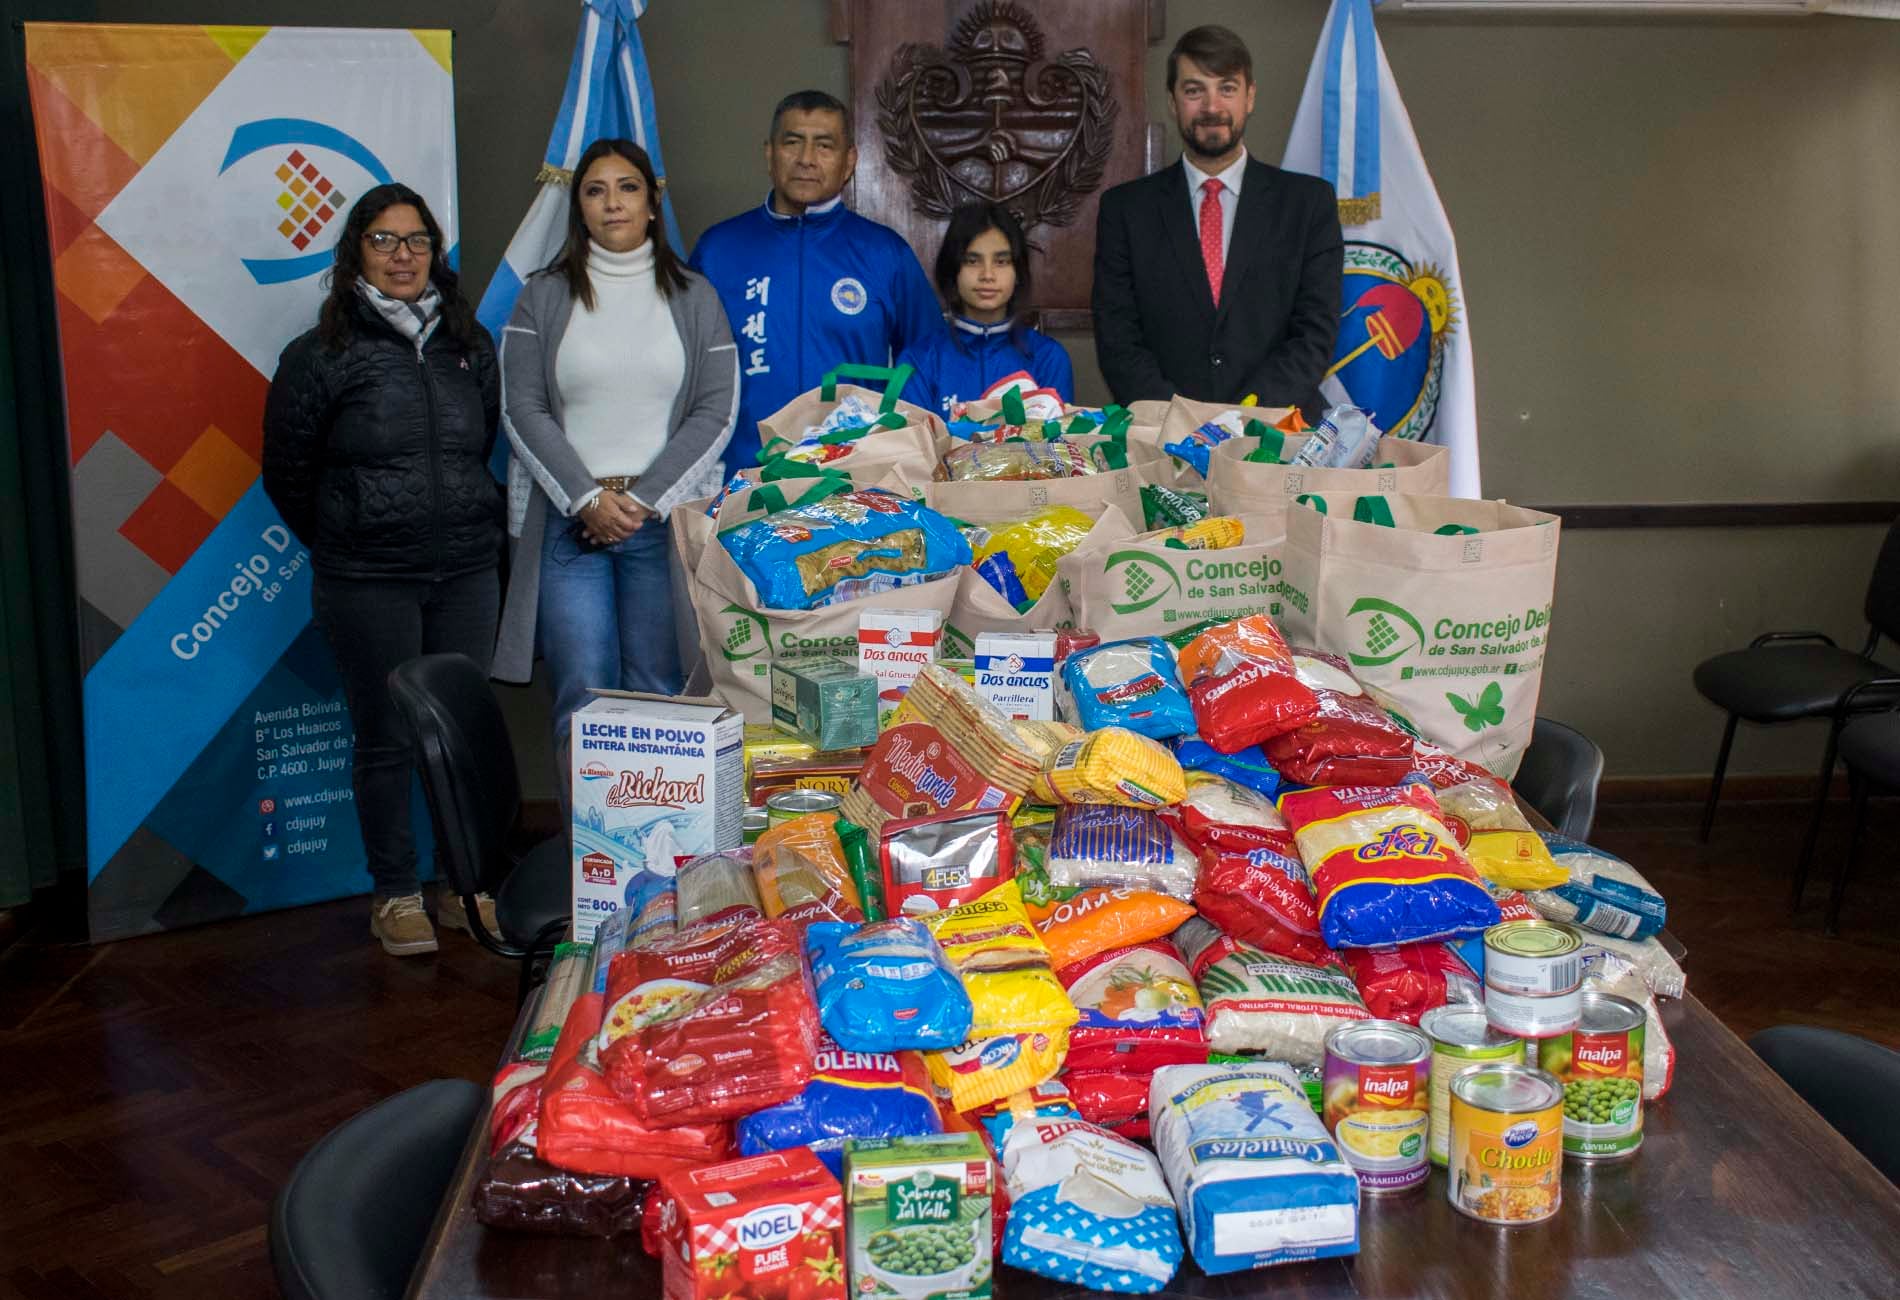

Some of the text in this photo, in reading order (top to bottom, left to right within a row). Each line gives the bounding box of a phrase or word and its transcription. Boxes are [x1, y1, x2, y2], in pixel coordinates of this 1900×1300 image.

[262, 551, 309, 602] de San
[1186, 555, 1282, 581] Concejo
[1188, 587, 1204, 598] de
[1209, 585, 1235, 598] San
[171, 555, 270, 660] Concejo
[1434, 614, 1520, 641] Concejo
[864, 648, 928, 665] Dos anclas
[1429, 645, 1445, 656] de
[1450, 644, 1475, 655] San
[1480, 640, 1528, 655] Salvador
[1413, 665, 1499, 677] www.cdjujuy.gob.ar
[980, 673, 1049, 689] Dos anclas
[992, 693, 1035, 704] Parrillera
[254, 702, 341, 724] Avenida Bolivia
[273, 727, 293, 740] Los
[296, 719, 341, 735] Huaicos
[582, 723, 706, 744] LECHE EN POLVO
[256, 748, 278, 761] San
[281, 739, 330, 757] Salvador
[334, 737, 348, 749] de
[582, 739, 705, 758] ENTERA INSTANTÁNEA
[280, 760, 308, 776] 4600
[317, 757, 346, 772] Jujuy
[618, 766, 705, 806] Richard
[799, 780, 849, 793] NORY
[286, 815, 326, 832] cdjujuy
[287, 838, 328, 854] cdjujuy
[925, 869, 968, 887] 4FLEX
[592, 899, 617, 912] 800
[1238, 1001, 1284, 1009] ARGENTINO
[1286, 1003, 1318, 1011] LITORAL
[1318, 1005, 1333, 1013] DEL
[1578, 1046, 1622, 1064] inalpa
[1364, 1077, 1409, 1096] inalpa
[1209, 1141, 1324, 1162] Cañuelas
[1480, 1147, 1553, 1169] Choclo
[1360, 1174, 1405, 1185] AMARILLO
[897, 1185, 952, 1207] Sabores
[918, 1201, 951, 1219] Valle
[742, 1214, 798, 1242] NOEL
[754, 1246, 787, 1267] PURÉ
